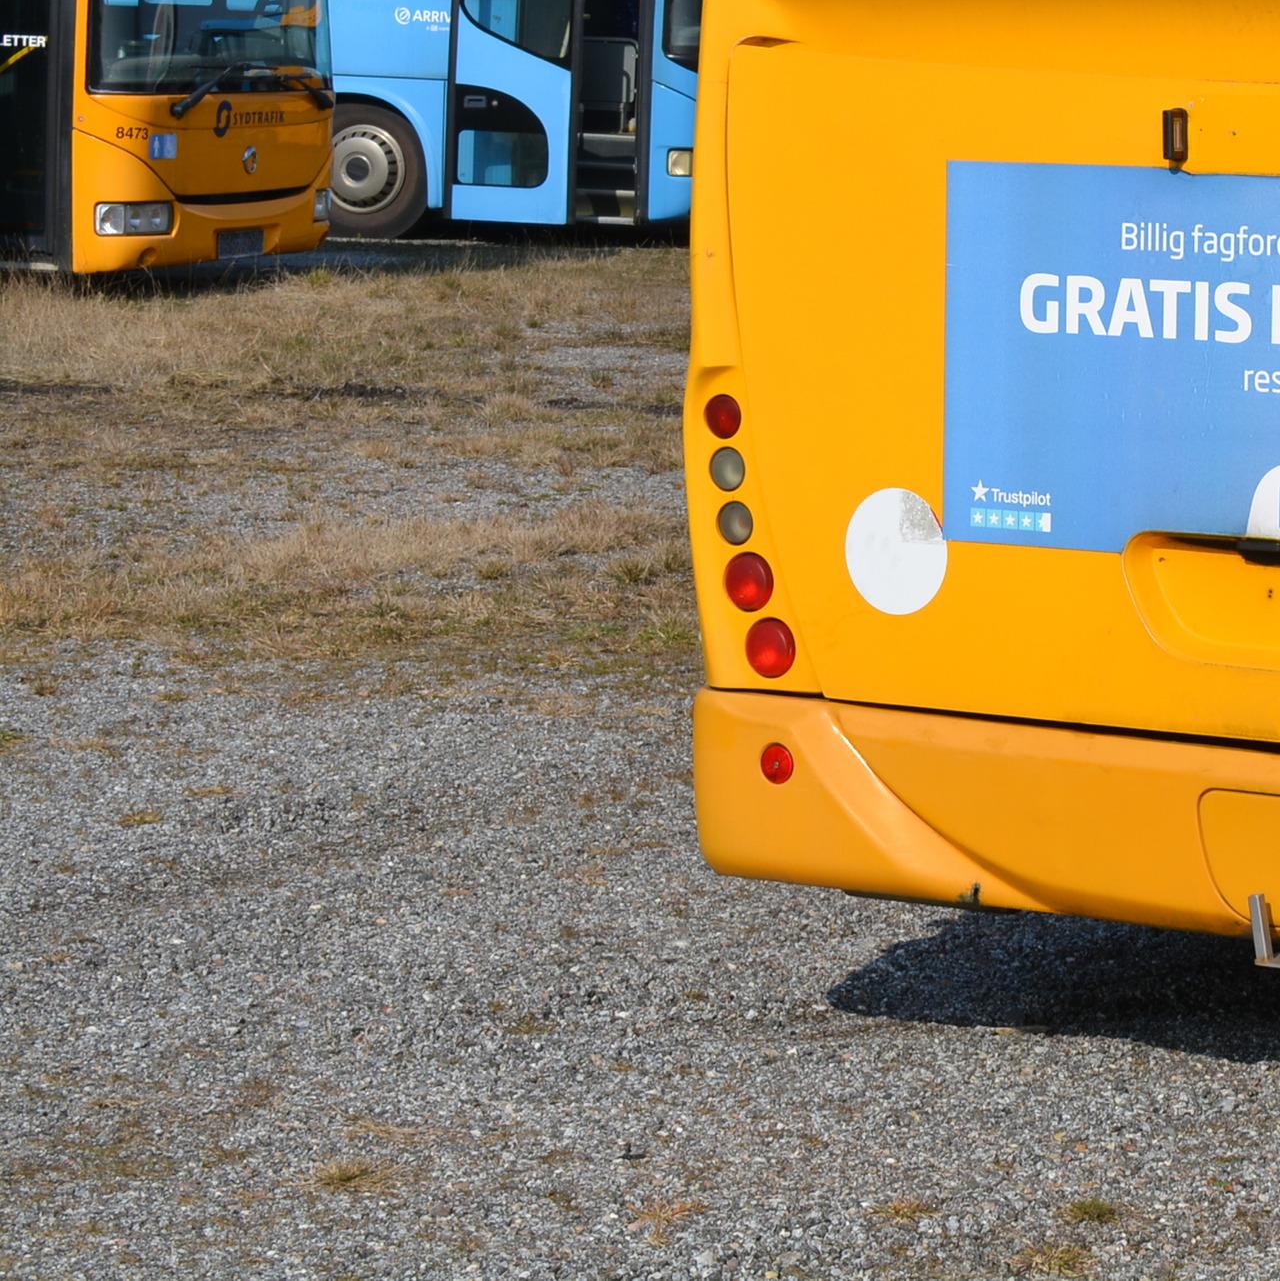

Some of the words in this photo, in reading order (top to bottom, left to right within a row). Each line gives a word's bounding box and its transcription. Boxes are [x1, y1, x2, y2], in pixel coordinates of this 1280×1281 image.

[412, 9, 452, 24] ARRIV
[233, 111, 285, 125] SYDTRAFIK
[115, 126, 149, 141] 8473
[1121, 222, 1185, 259] Billig
[1020, 273, 1251, 344] GRATIS
[991, 488, 1051, 508] Trustpilot
